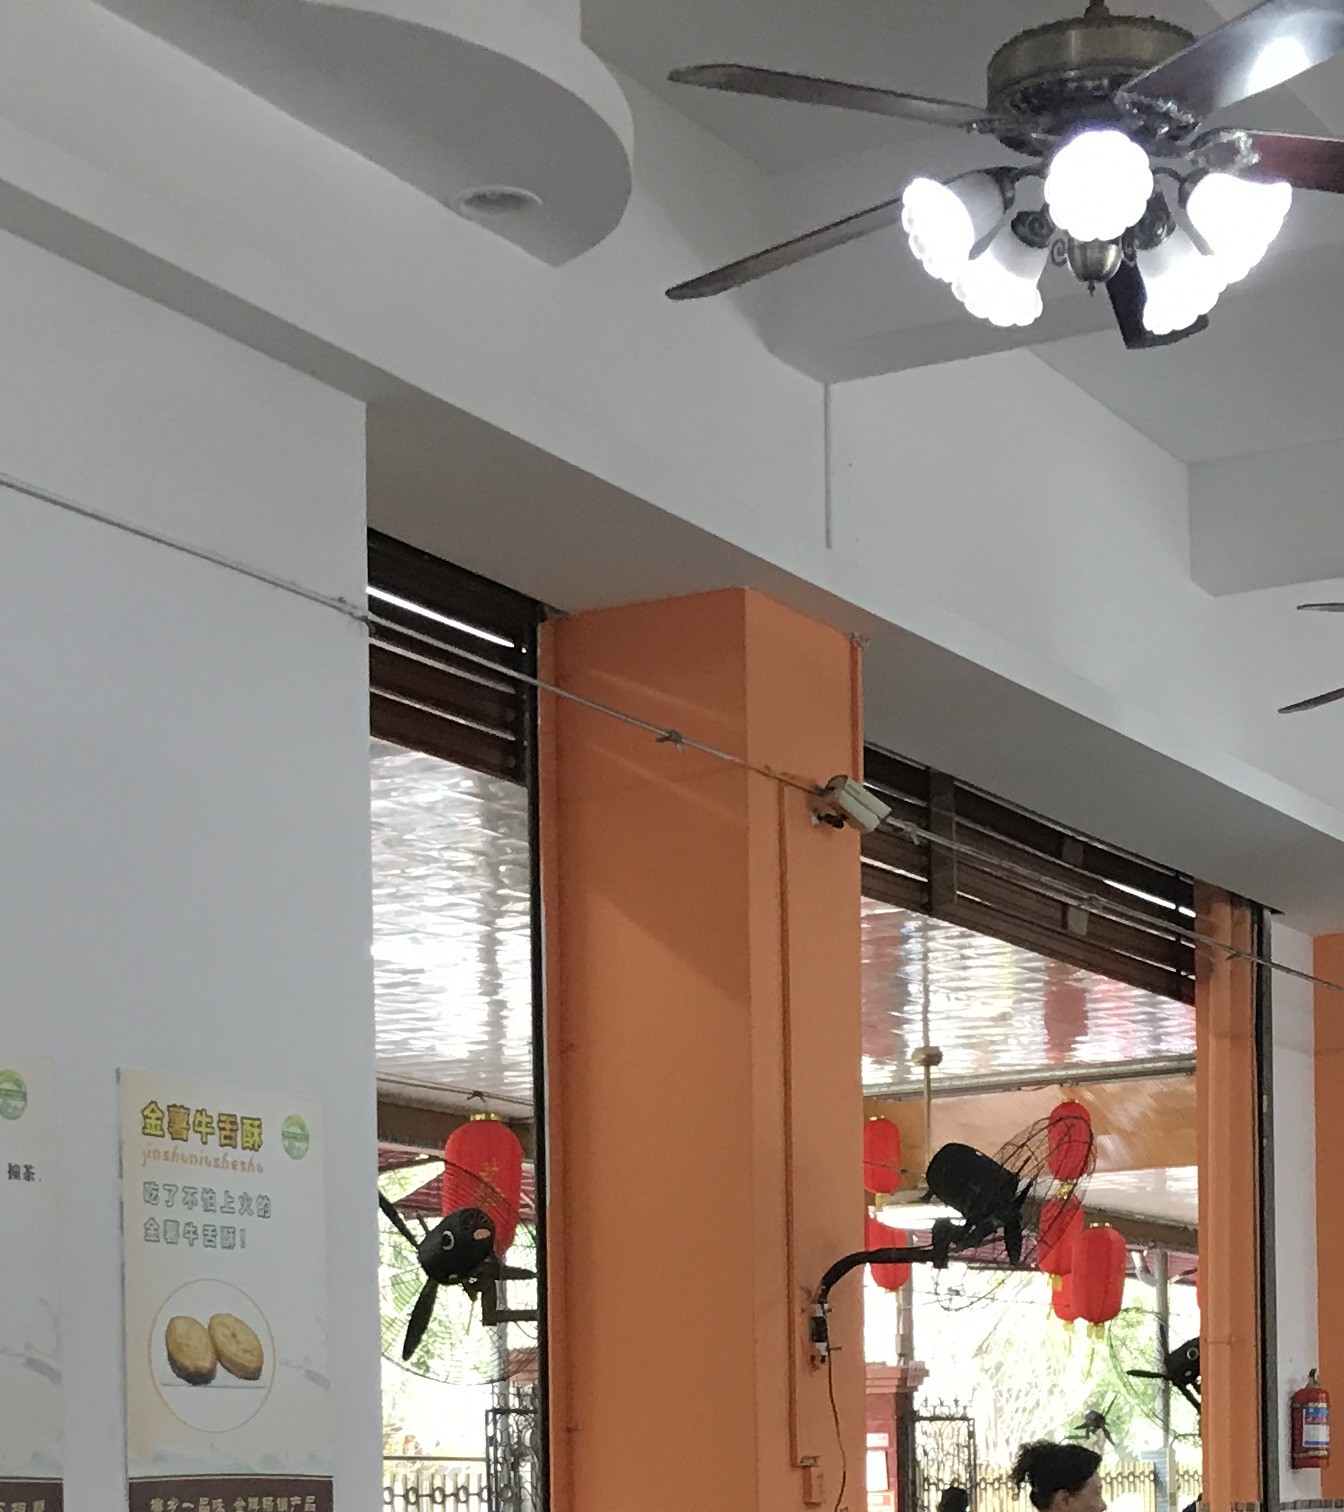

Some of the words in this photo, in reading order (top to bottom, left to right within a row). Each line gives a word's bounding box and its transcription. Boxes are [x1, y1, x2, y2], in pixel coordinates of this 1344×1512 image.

[140, 1099, 264, 1152] 金薯牛舌酥
[142, 1180, 272, 1219] 吃了不怕上火的
